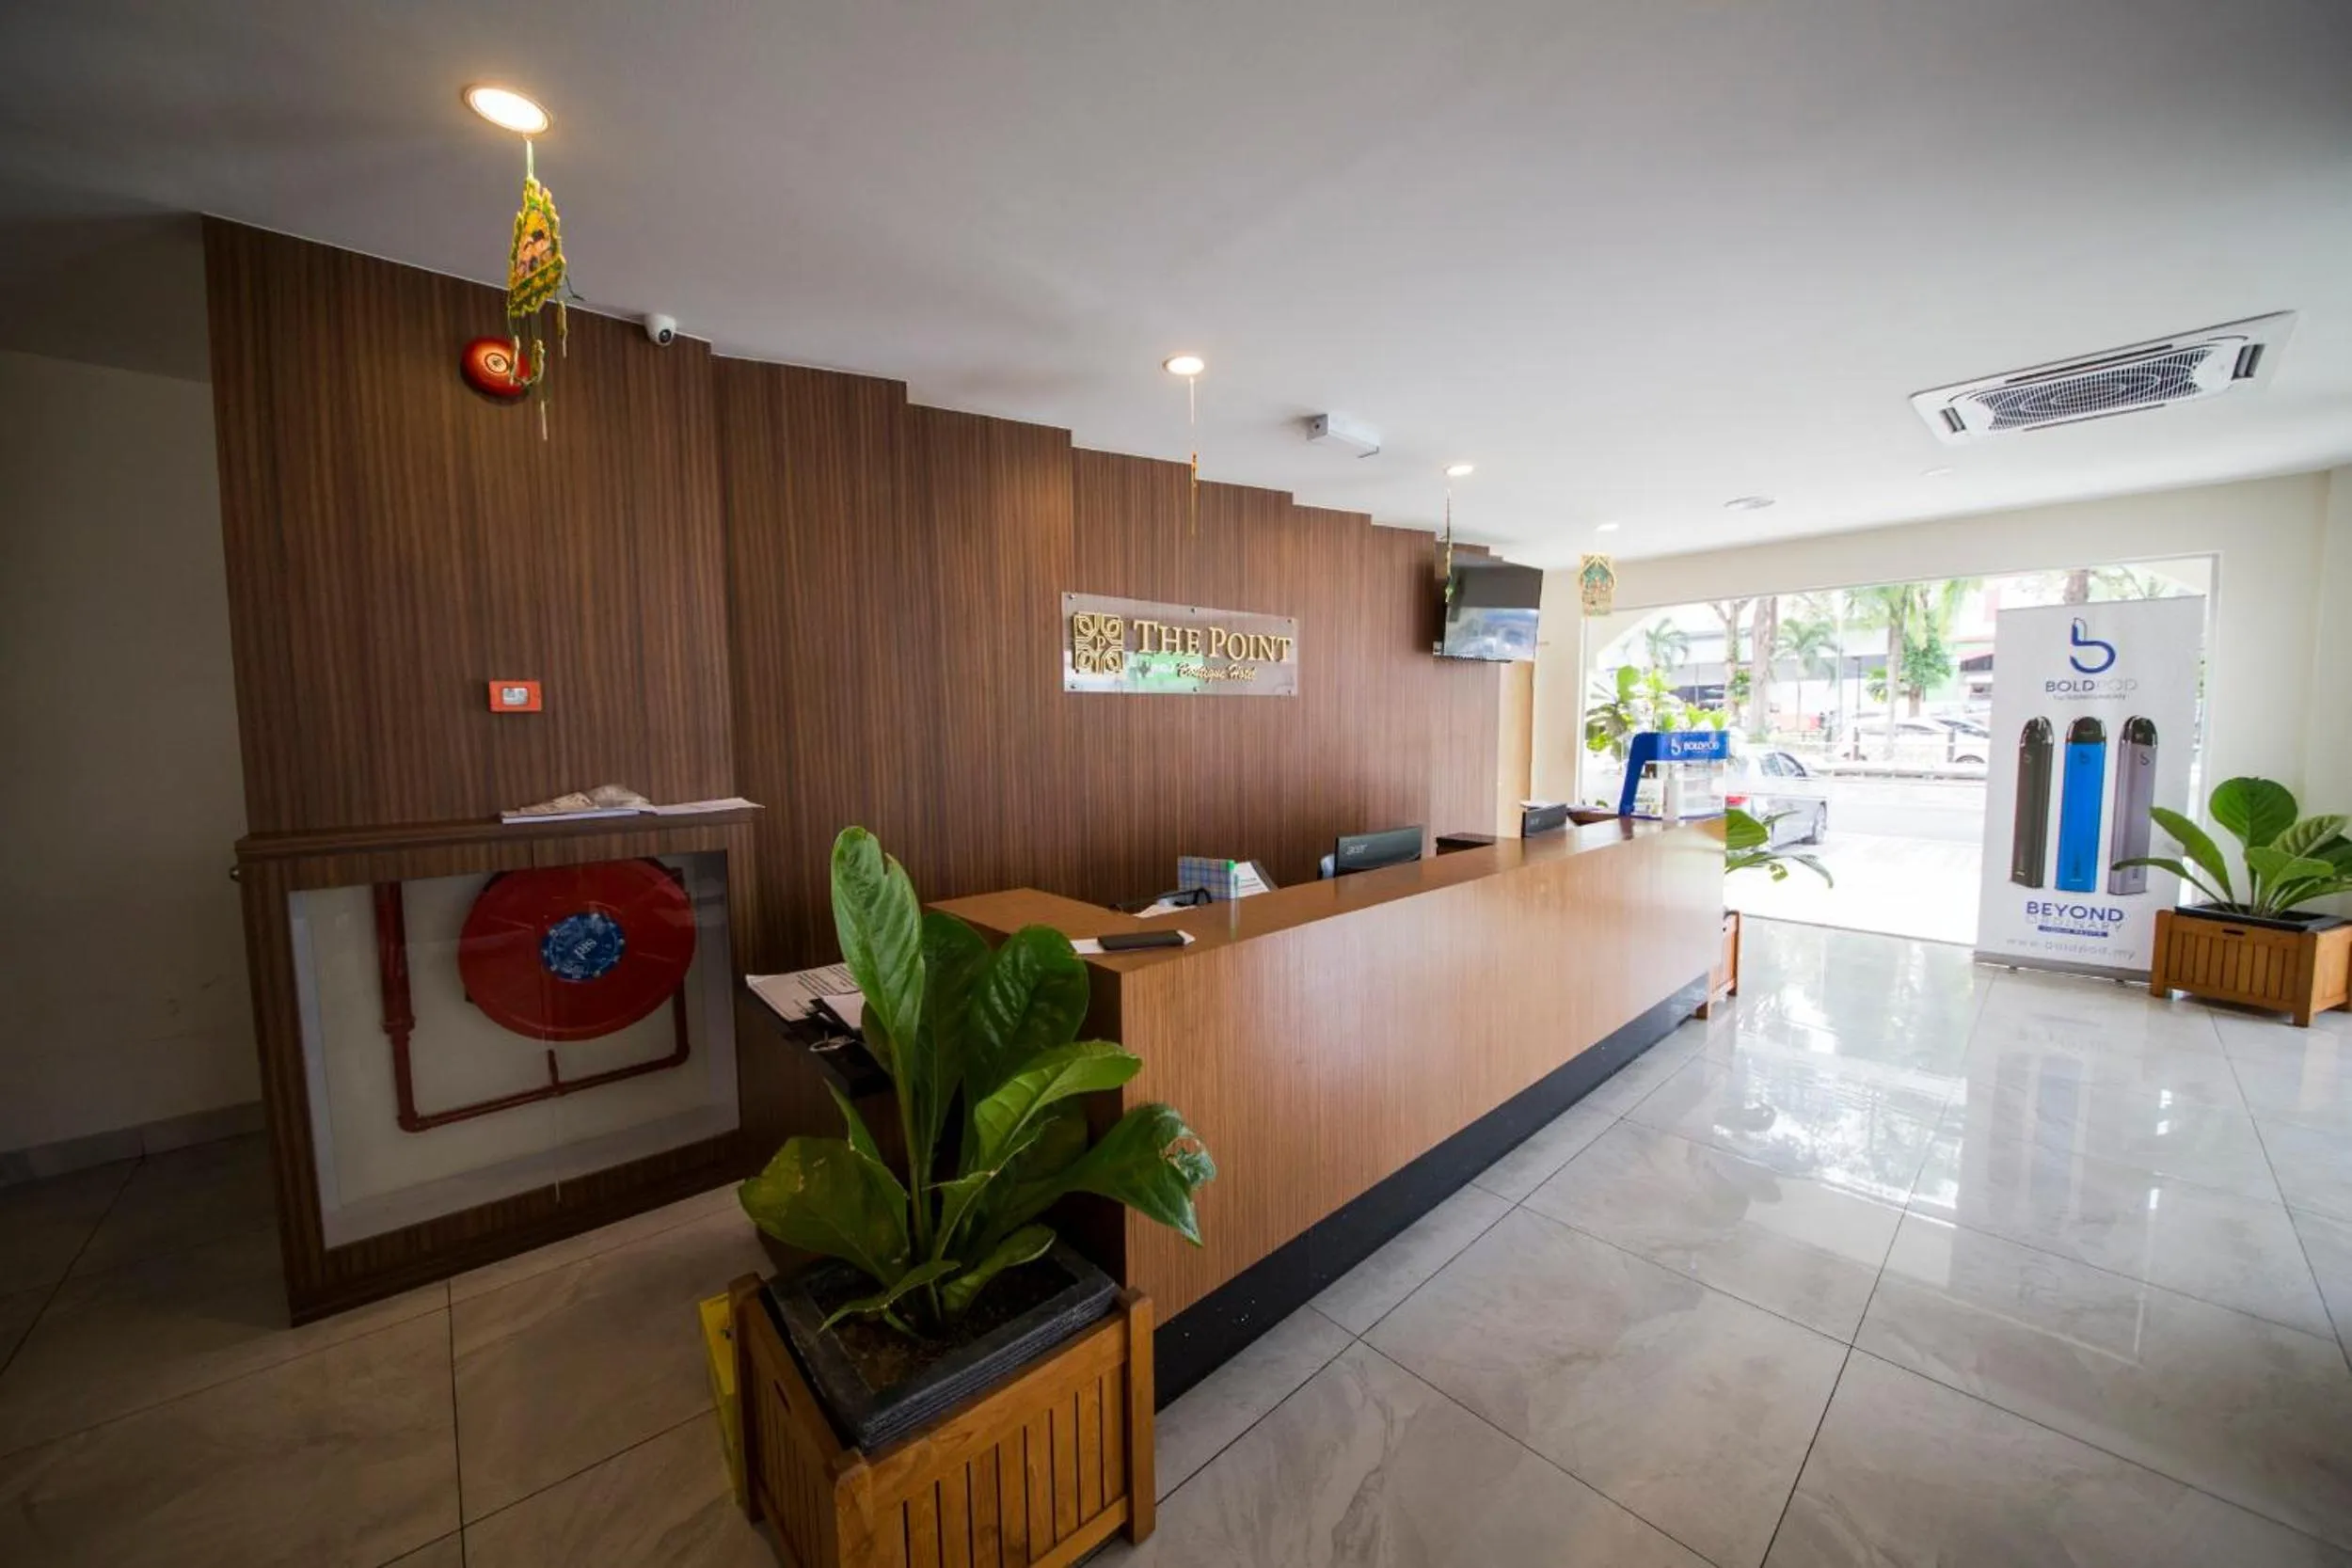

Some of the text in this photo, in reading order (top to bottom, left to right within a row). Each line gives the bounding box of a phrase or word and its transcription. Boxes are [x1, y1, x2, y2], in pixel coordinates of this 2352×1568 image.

[1132, 620, 1294, 663] THE POINT
[1228, 663, 1258, 681] Hotel
[2026, 901, 2124, 923] BEYOND
